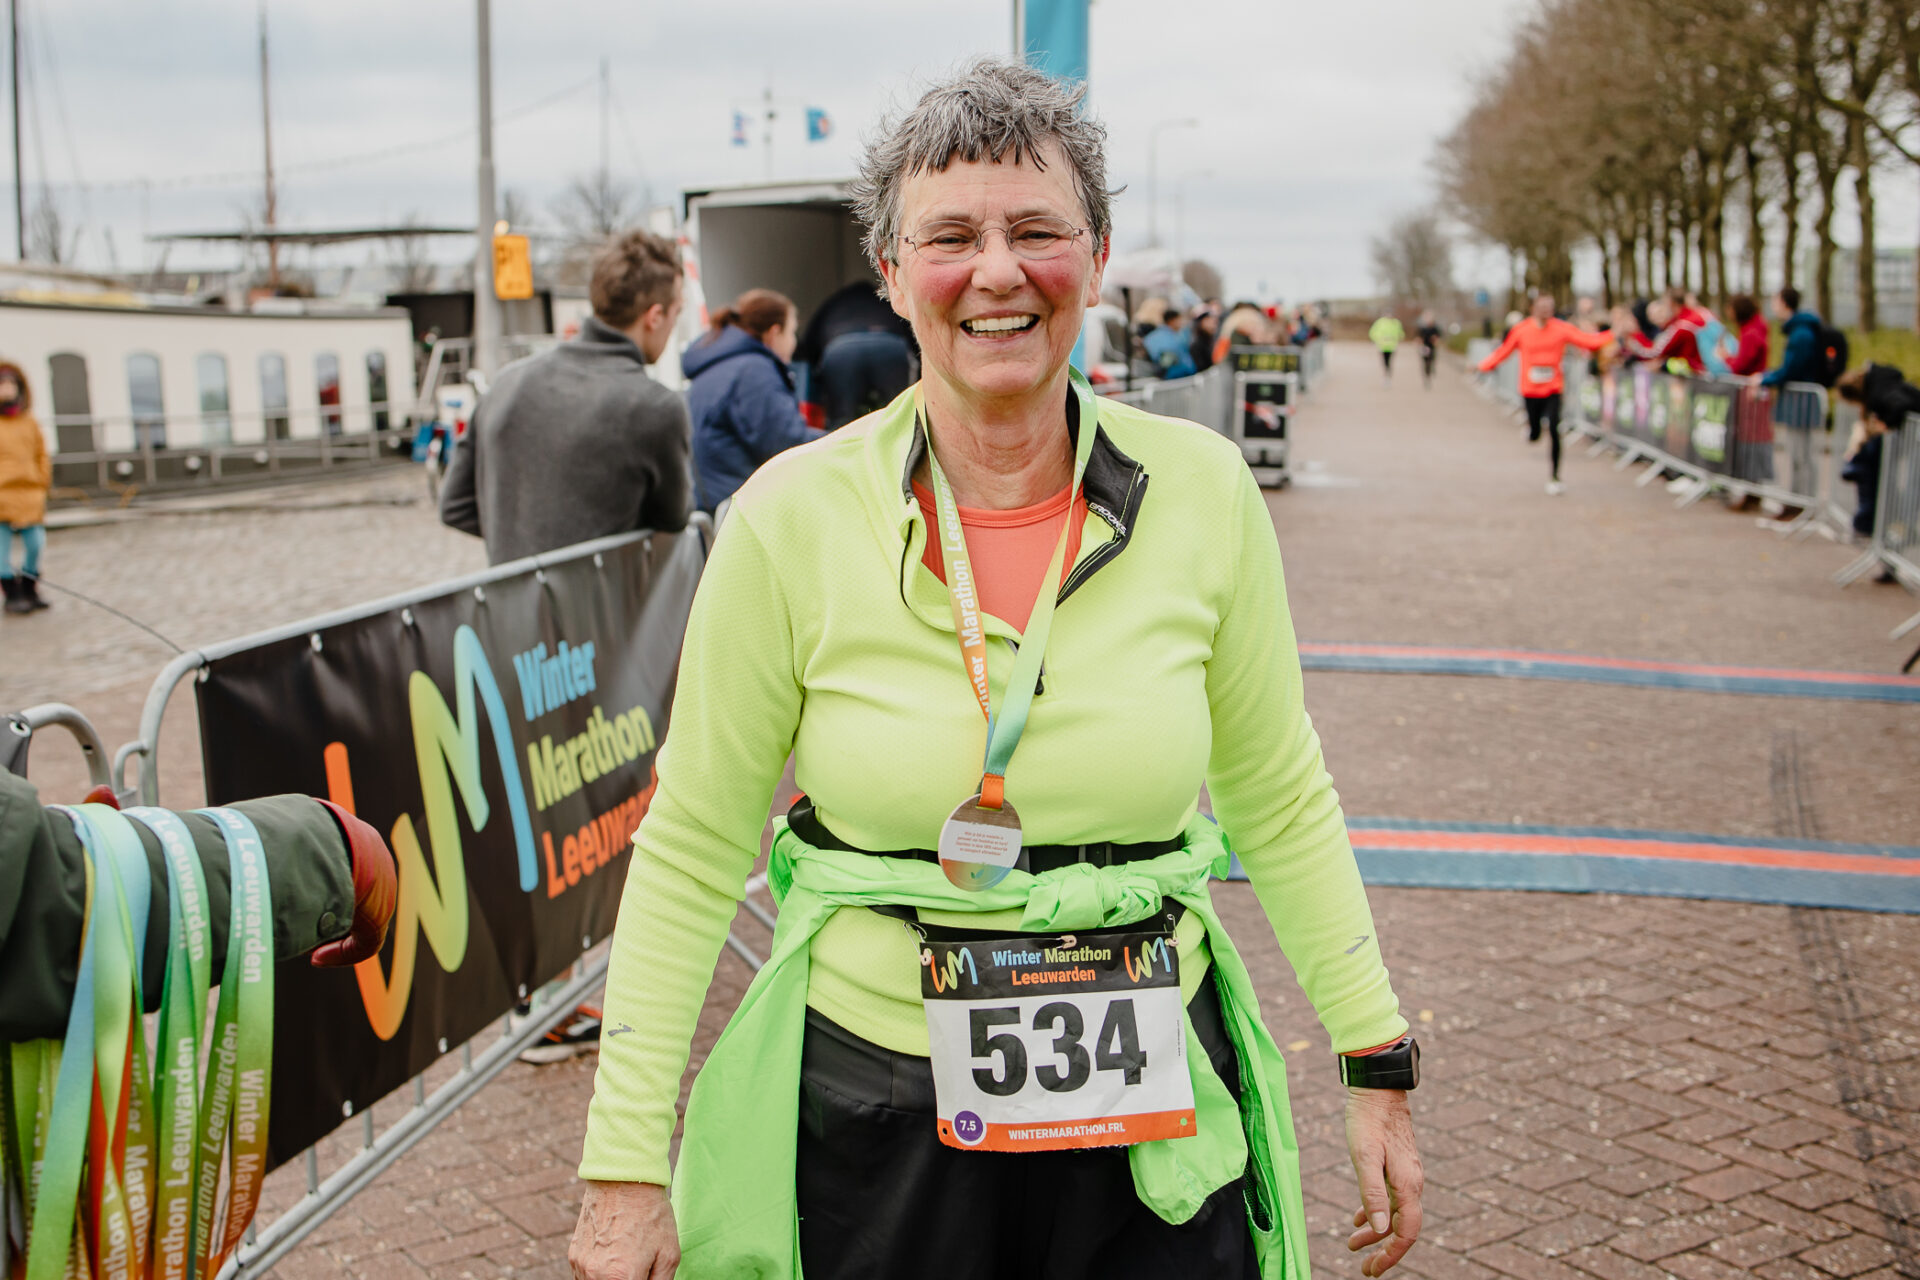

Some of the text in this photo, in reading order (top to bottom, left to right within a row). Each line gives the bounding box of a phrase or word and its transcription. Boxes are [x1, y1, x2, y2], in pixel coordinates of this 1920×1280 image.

[1089, 502, 1127, 537] BROOKS
[953, 560, 981, 648] Marathon
[512, 639, 597, 722] Winter
[527, 704, 656, 812] Marathon
[154, 820, 206, 961] Leeuwarden
[237, 838, 267, 983] Leeuwarden
[992, 945, 1112, 967] Winter Marathon
[1011, 966, 1096, 986] Leeuwarden
[201, 1022, 239, 1154] Leeuwarden
[968, 998, 1148, 1097] 534
[166, 1036, 195, 1187] Leeuwarden
[237, 1068, 265, 1144] Winter
[959, 1119, 977, 1131] 7.5
[1008, 1123, 1126, 1140] WINTERMARATHON.FRL
[228, 1153, 261, 1241] Marathon
